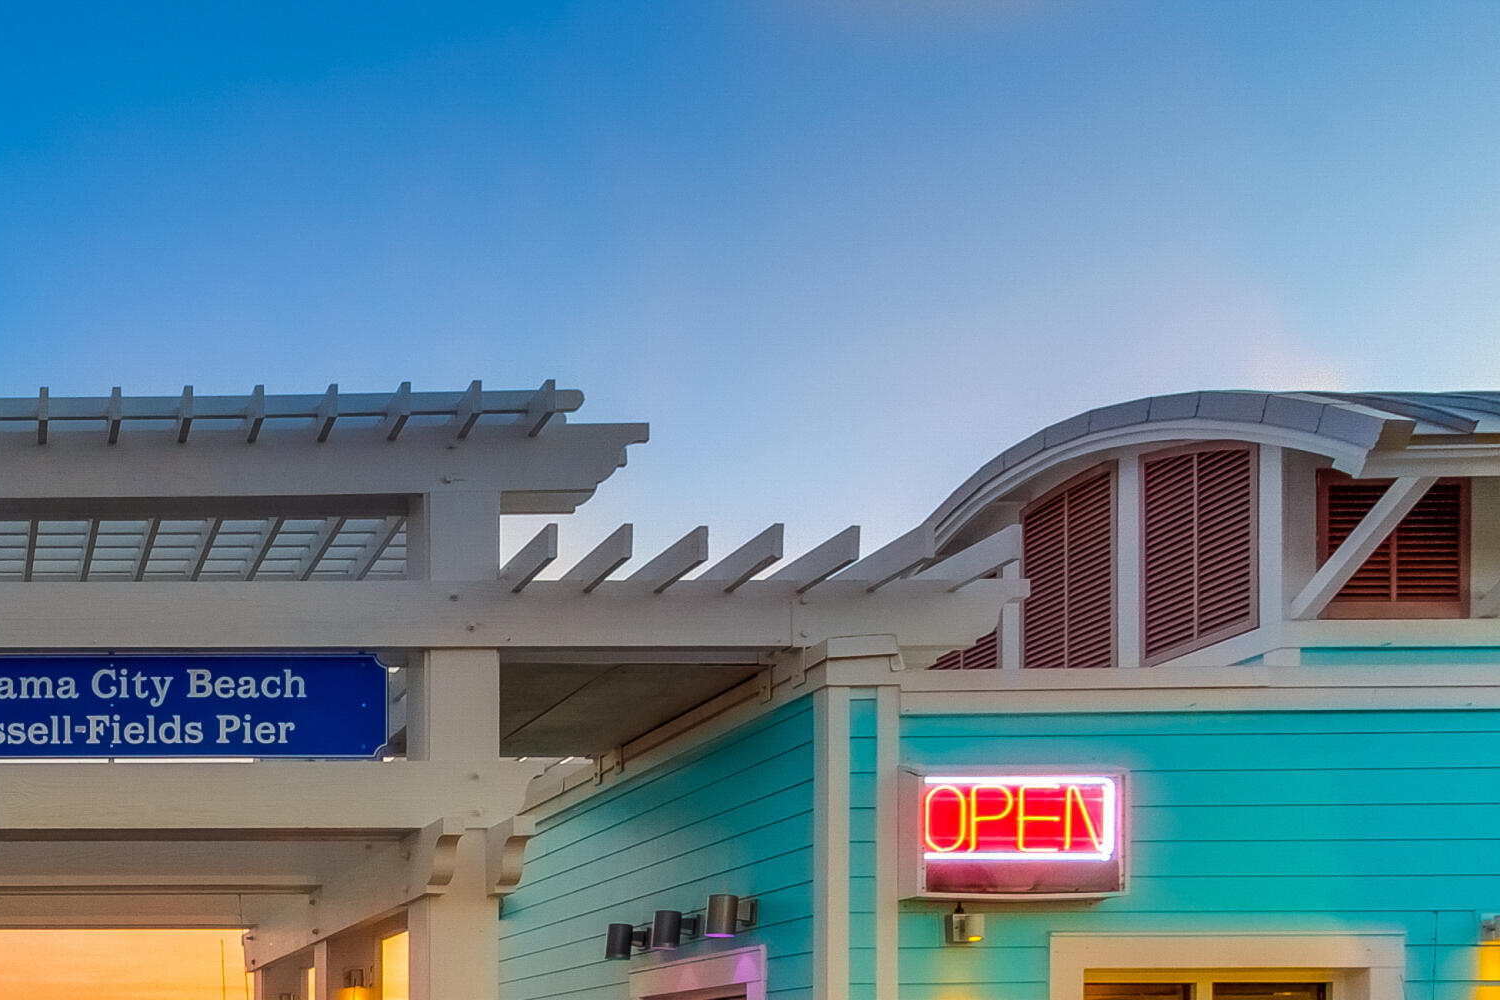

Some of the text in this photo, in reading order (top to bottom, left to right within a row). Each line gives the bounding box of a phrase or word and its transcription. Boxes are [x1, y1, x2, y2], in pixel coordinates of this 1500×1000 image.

[91, 668, 174, 707] City
[186, 669, 308, 699] Beach
[216, 714, 296, 745] Pier
[924, 784, 1110, 853] OPEN
